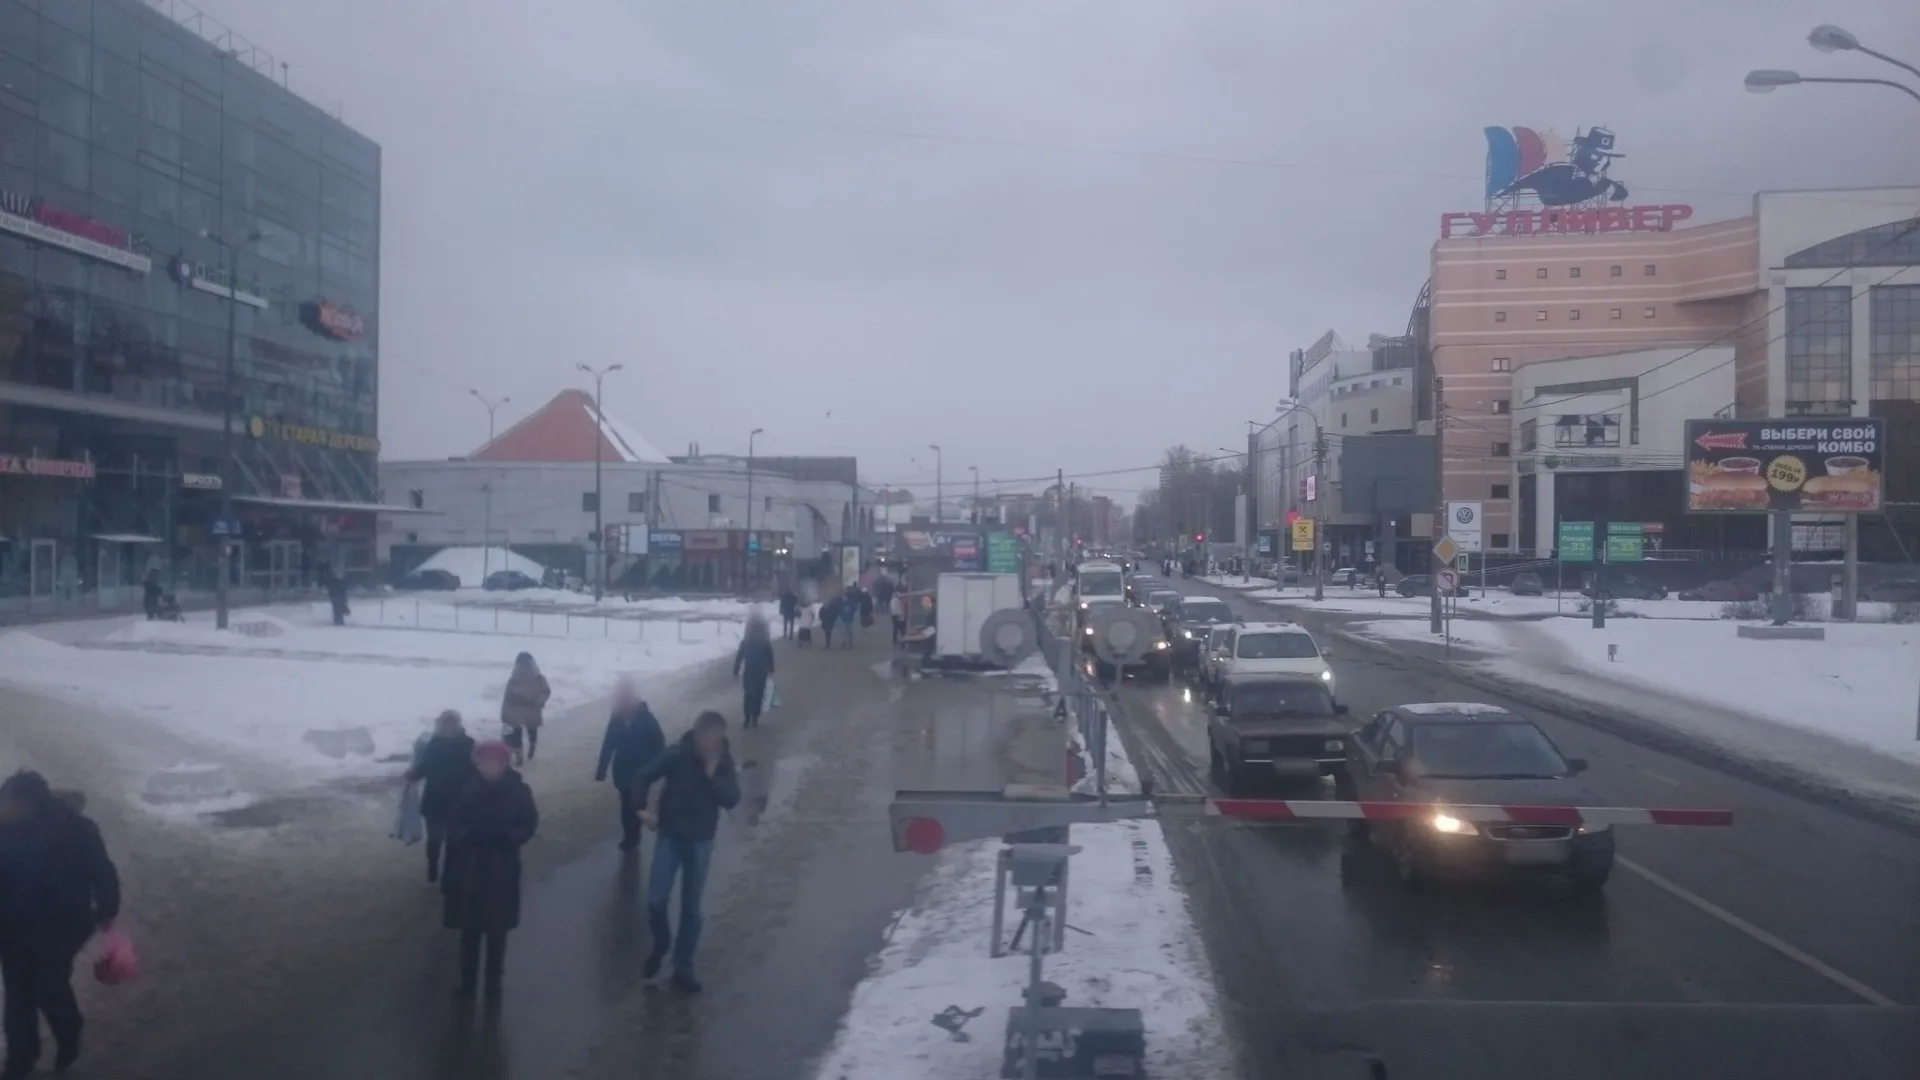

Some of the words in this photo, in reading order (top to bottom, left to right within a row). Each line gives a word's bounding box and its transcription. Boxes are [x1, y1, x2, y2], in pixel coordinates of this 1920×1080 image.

[1441, 204, 1693, 239] ГУЛЛИВЕР
[1761, 428, 1828, 440] ВЫБЕРИ
[1832, 424, 1876, 439] СВОЙ
[1818, 441, 1876, 453] КОМБО
